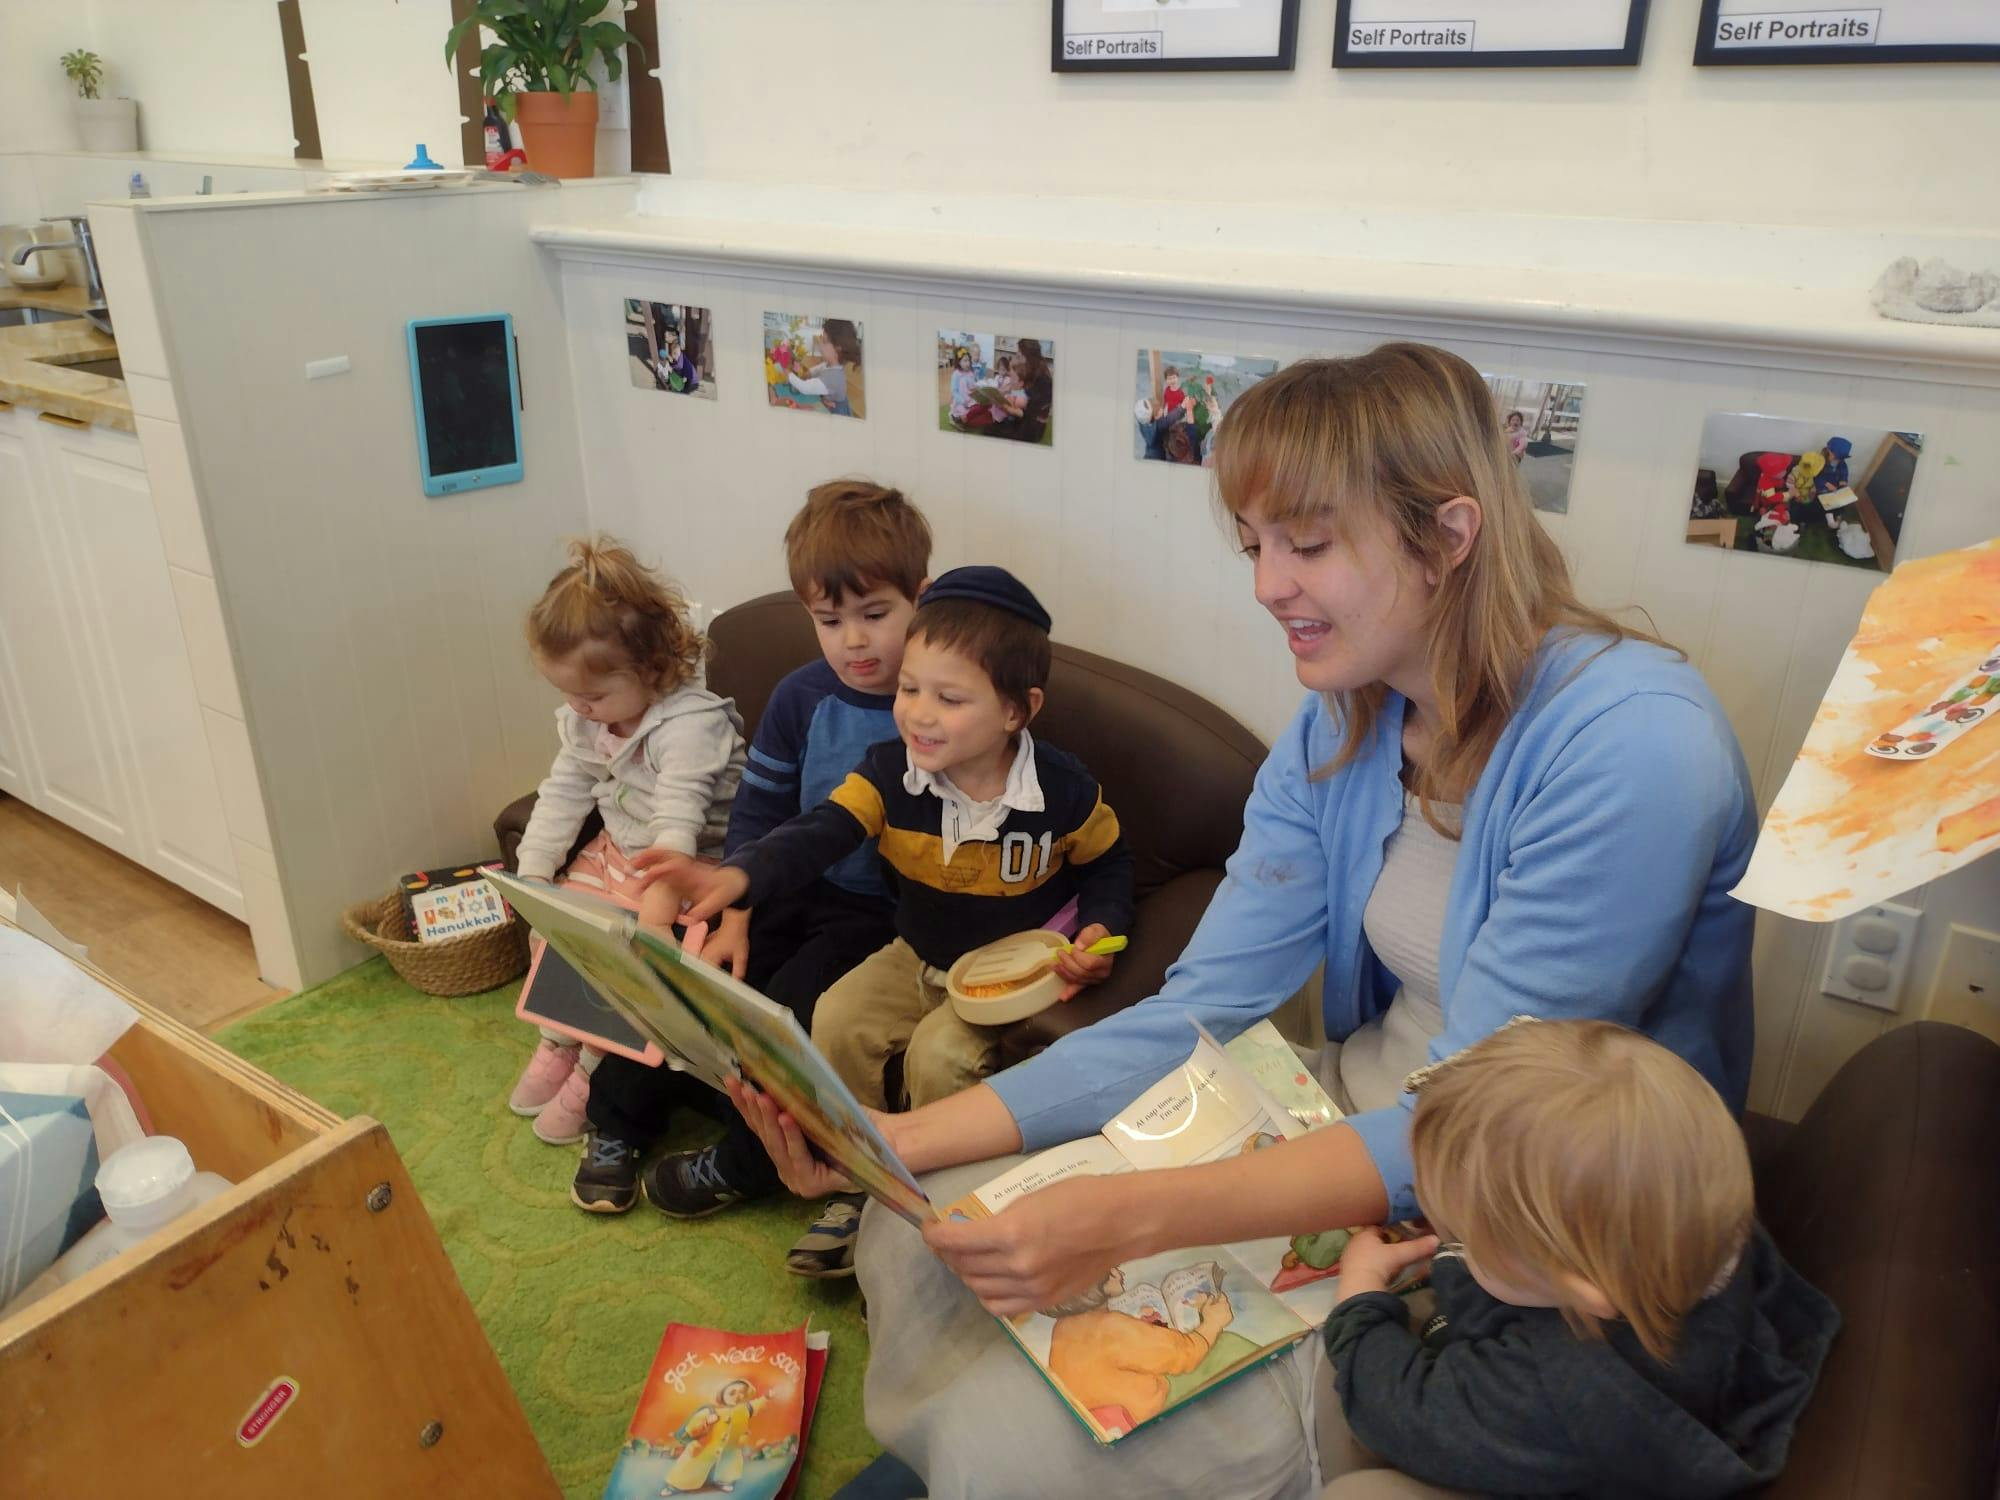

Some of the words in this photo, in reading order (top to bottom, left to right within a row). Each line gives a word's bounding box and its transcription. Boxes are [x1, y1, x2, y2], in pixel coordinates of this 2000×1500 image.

[1351, 29, 1386, 46] Self
[1390, 28, 1467, 46] Portraits
[1719, 21, 1763, 41] Self
[1768, 18, 1869, 39] Portraits
[1066, 40, 1093, 55] Self
[1097, 38, 1157, 54] Portraits
[1000, 830, 1052, 884] 01
[436, 894, 457, 905] my
[461, 884, 490, 898] first
[426, 912, 502, 937] Hanukkah
[664, 1351, 704, 1393] get
[710, 1345, 766, 1365] well
